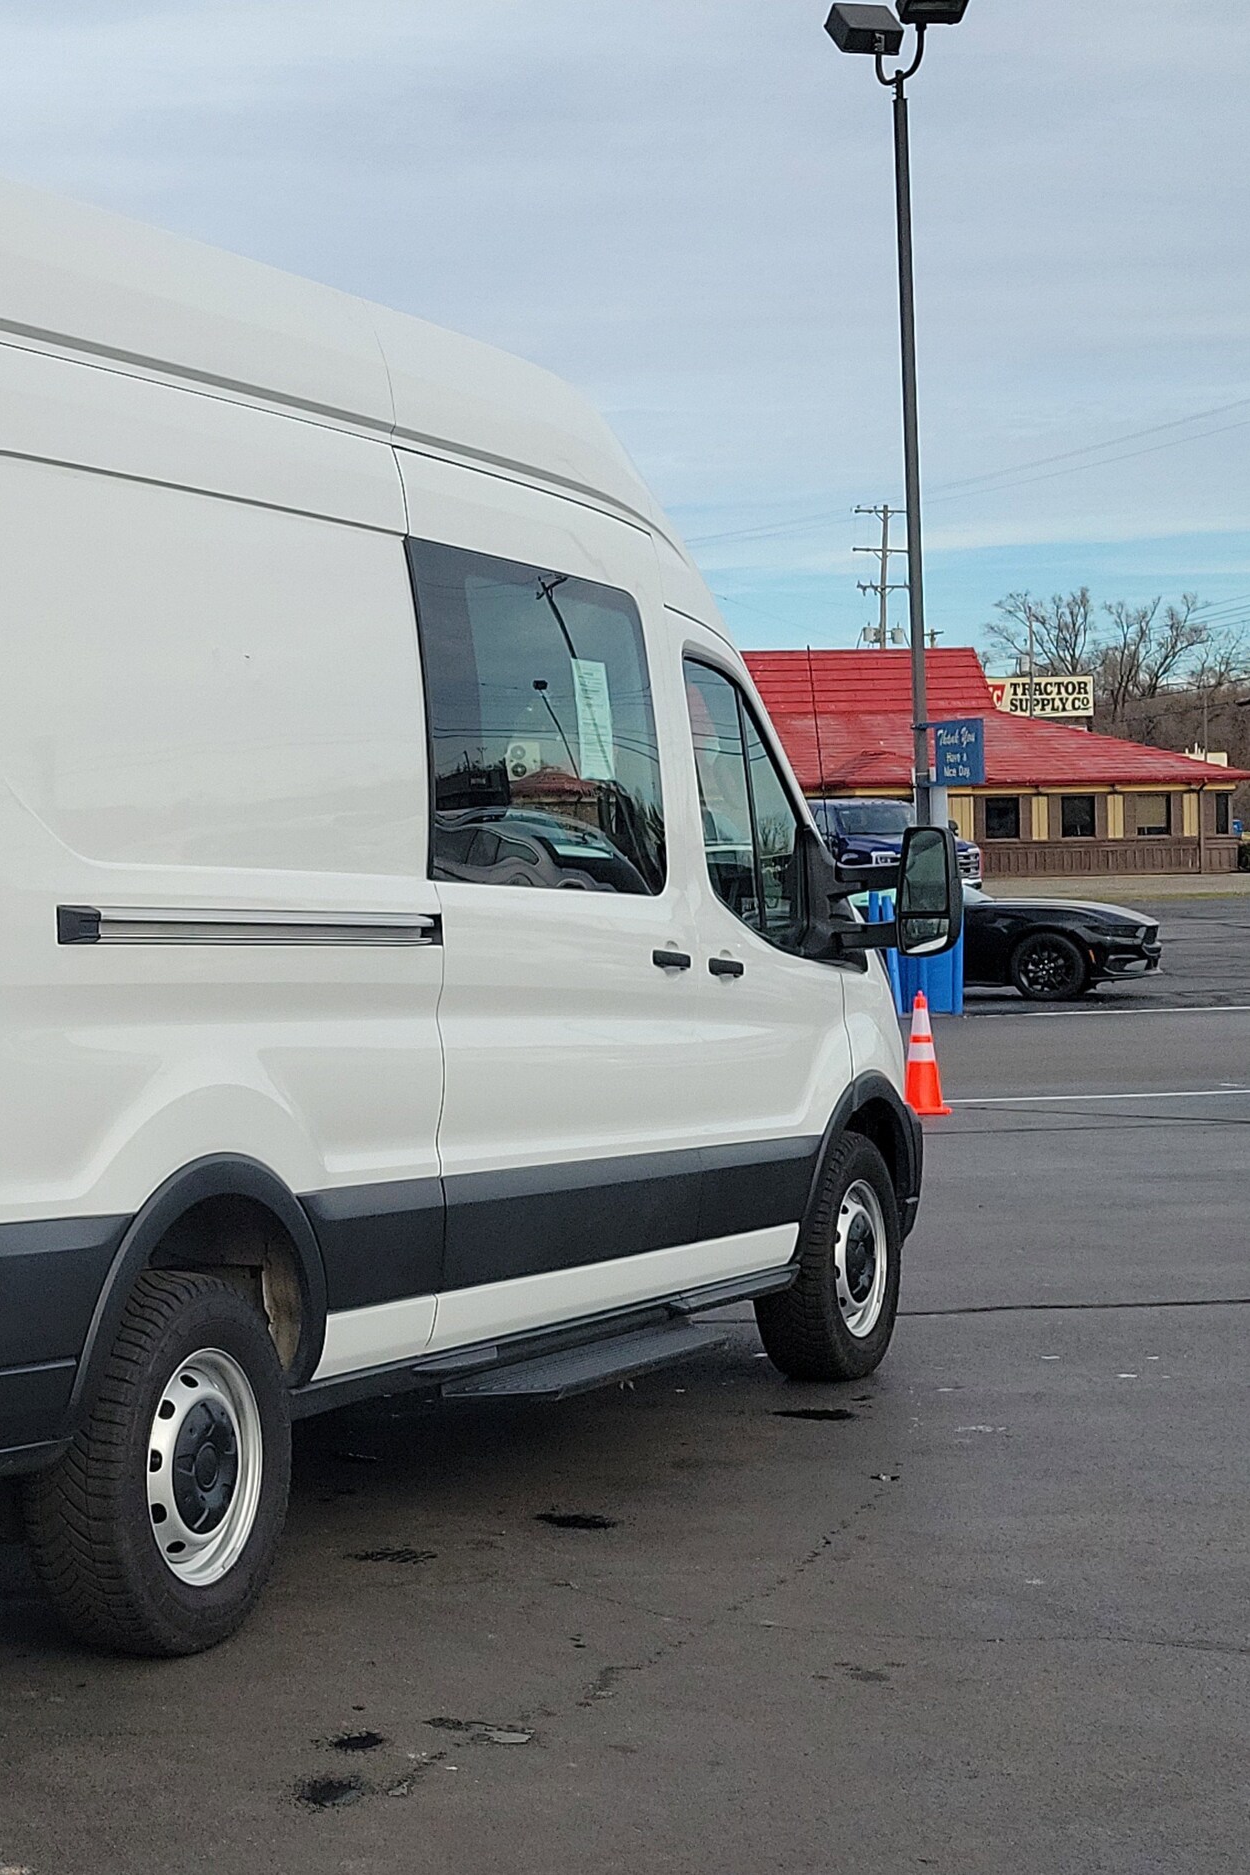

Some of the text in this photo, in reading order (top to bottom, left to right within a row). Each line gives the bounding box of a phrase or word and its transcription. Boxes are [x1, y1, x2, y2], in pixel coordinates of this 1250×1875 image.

[1010, 681, 1088, 696] TRACTOR
[1010, 697, 1069, 712] SUPPLY
[937, 727, 976, 748] Thank You
